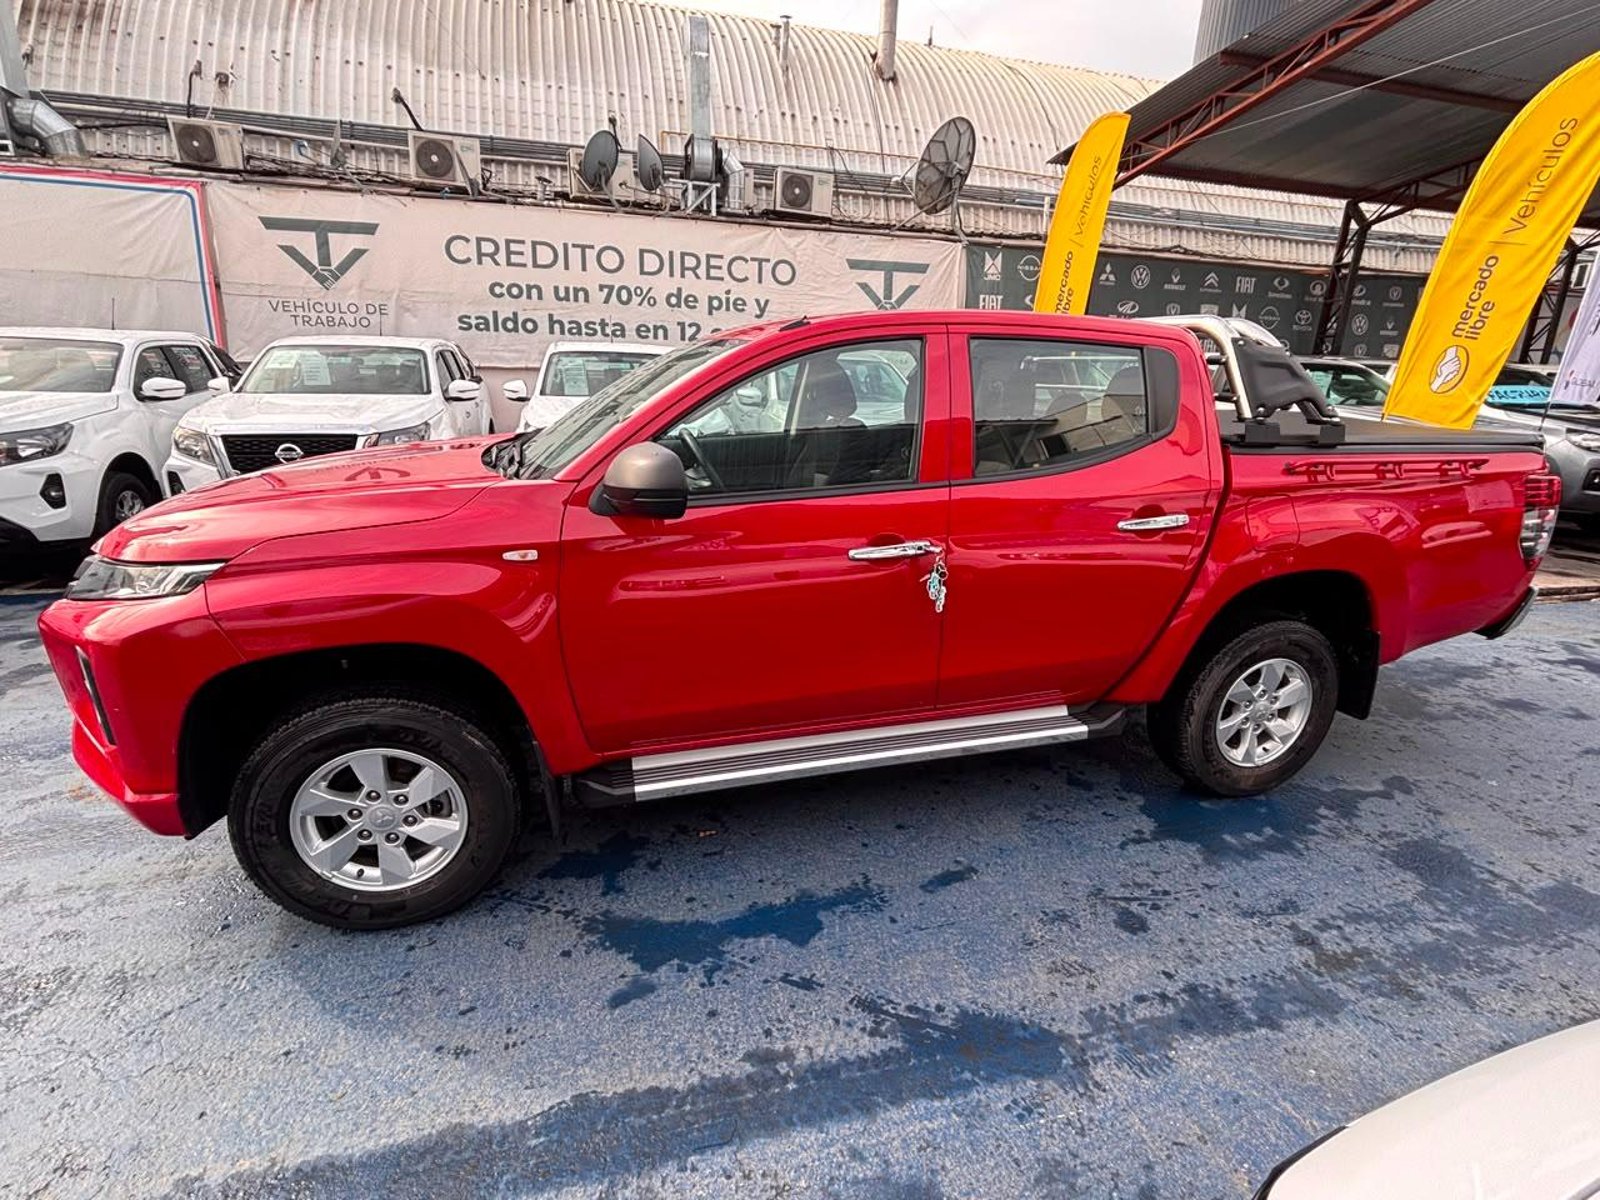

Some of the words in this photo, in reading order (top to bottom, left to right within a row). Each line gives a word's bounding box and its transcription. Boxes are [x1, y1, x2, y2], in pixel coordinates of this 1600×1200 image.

[1503, 116, 1578, 234] Vehículos
[444, 234, 625, 274] CREDITO
[638, 248, 796, 286] DIRECTO
[488, 281, 543, 301] con
[553, 284, 590, 304] un
[599, 283, 657, 308] 70%
[665, 287, 699, 310] de
[708, 289, 747, 316] pie
[754, 297, 770, 318] y
[1060, 287, 1074, 314] ibre
[1235, 276, 1257, 294] FIAT
[1452, 255, 1499, 337] mercado
[268, 298, 360, 315] VEHÍCULO
[365, 303, 389, 316] DE
[979, 294, 1004, 310] FIAT
[290, 314, 371, 328] TRABAJO
[457, 310, 539, 334] saldo
[548, 313, 627, 339] hasta
[635, 322, 669, 341] en
[676, 321, 702, 342] 12
[1464, 301, 1496, 340] libre
